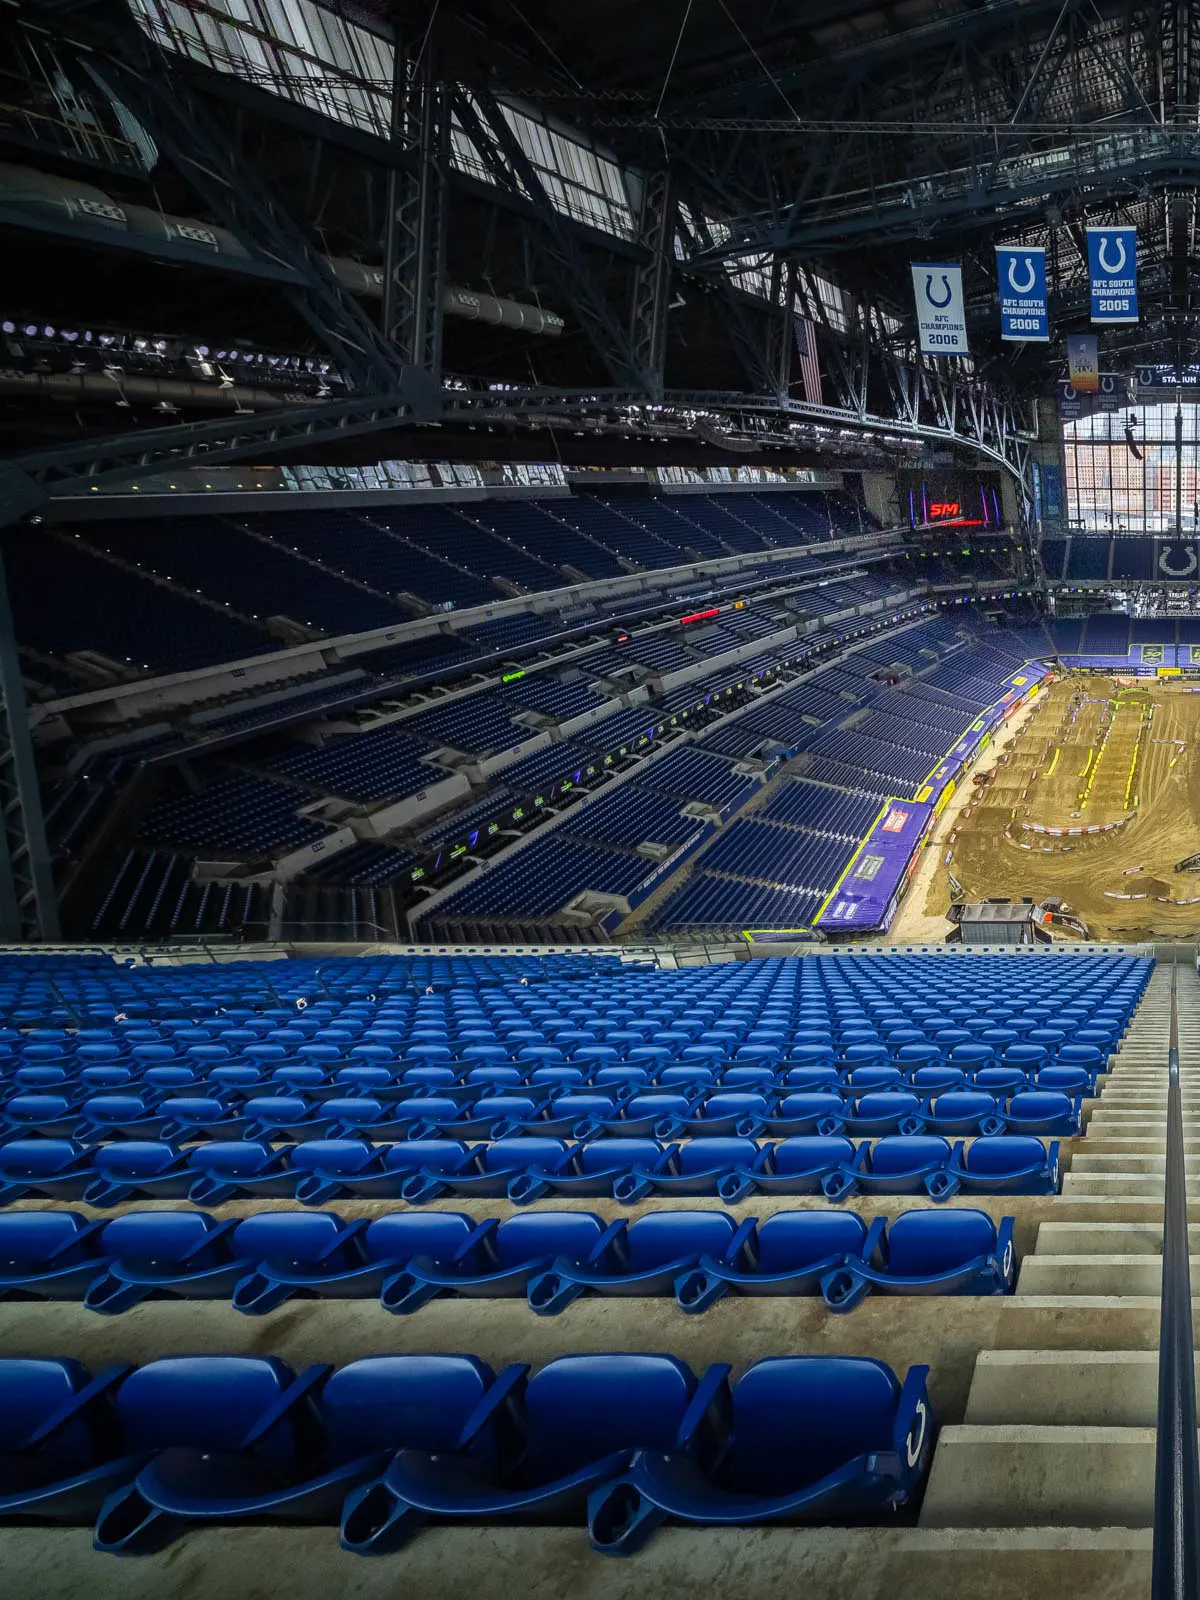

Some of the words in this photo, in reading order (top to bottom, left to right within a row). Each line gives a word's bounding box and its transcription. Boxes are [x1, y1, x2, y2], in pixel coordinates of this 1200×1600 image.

[1092, 280, 1106, 288] AFC
[1108, 280, 1134, 288] SOUTH
[1092, 288, 1136, 296] CHAMPIONS
[1002, 299, 1017, 307] AFC
[1018, 299, 1044, 307] SOUTH
[1099, 300, 1130, 311] 2005
[1002, 307, 1046, 316] CHAMPIONS
[921, 322, 964, 331] CHAMPIONS
[1010, 318, 1040, 330] 2006
[928, 334, 958, 345] 2006
